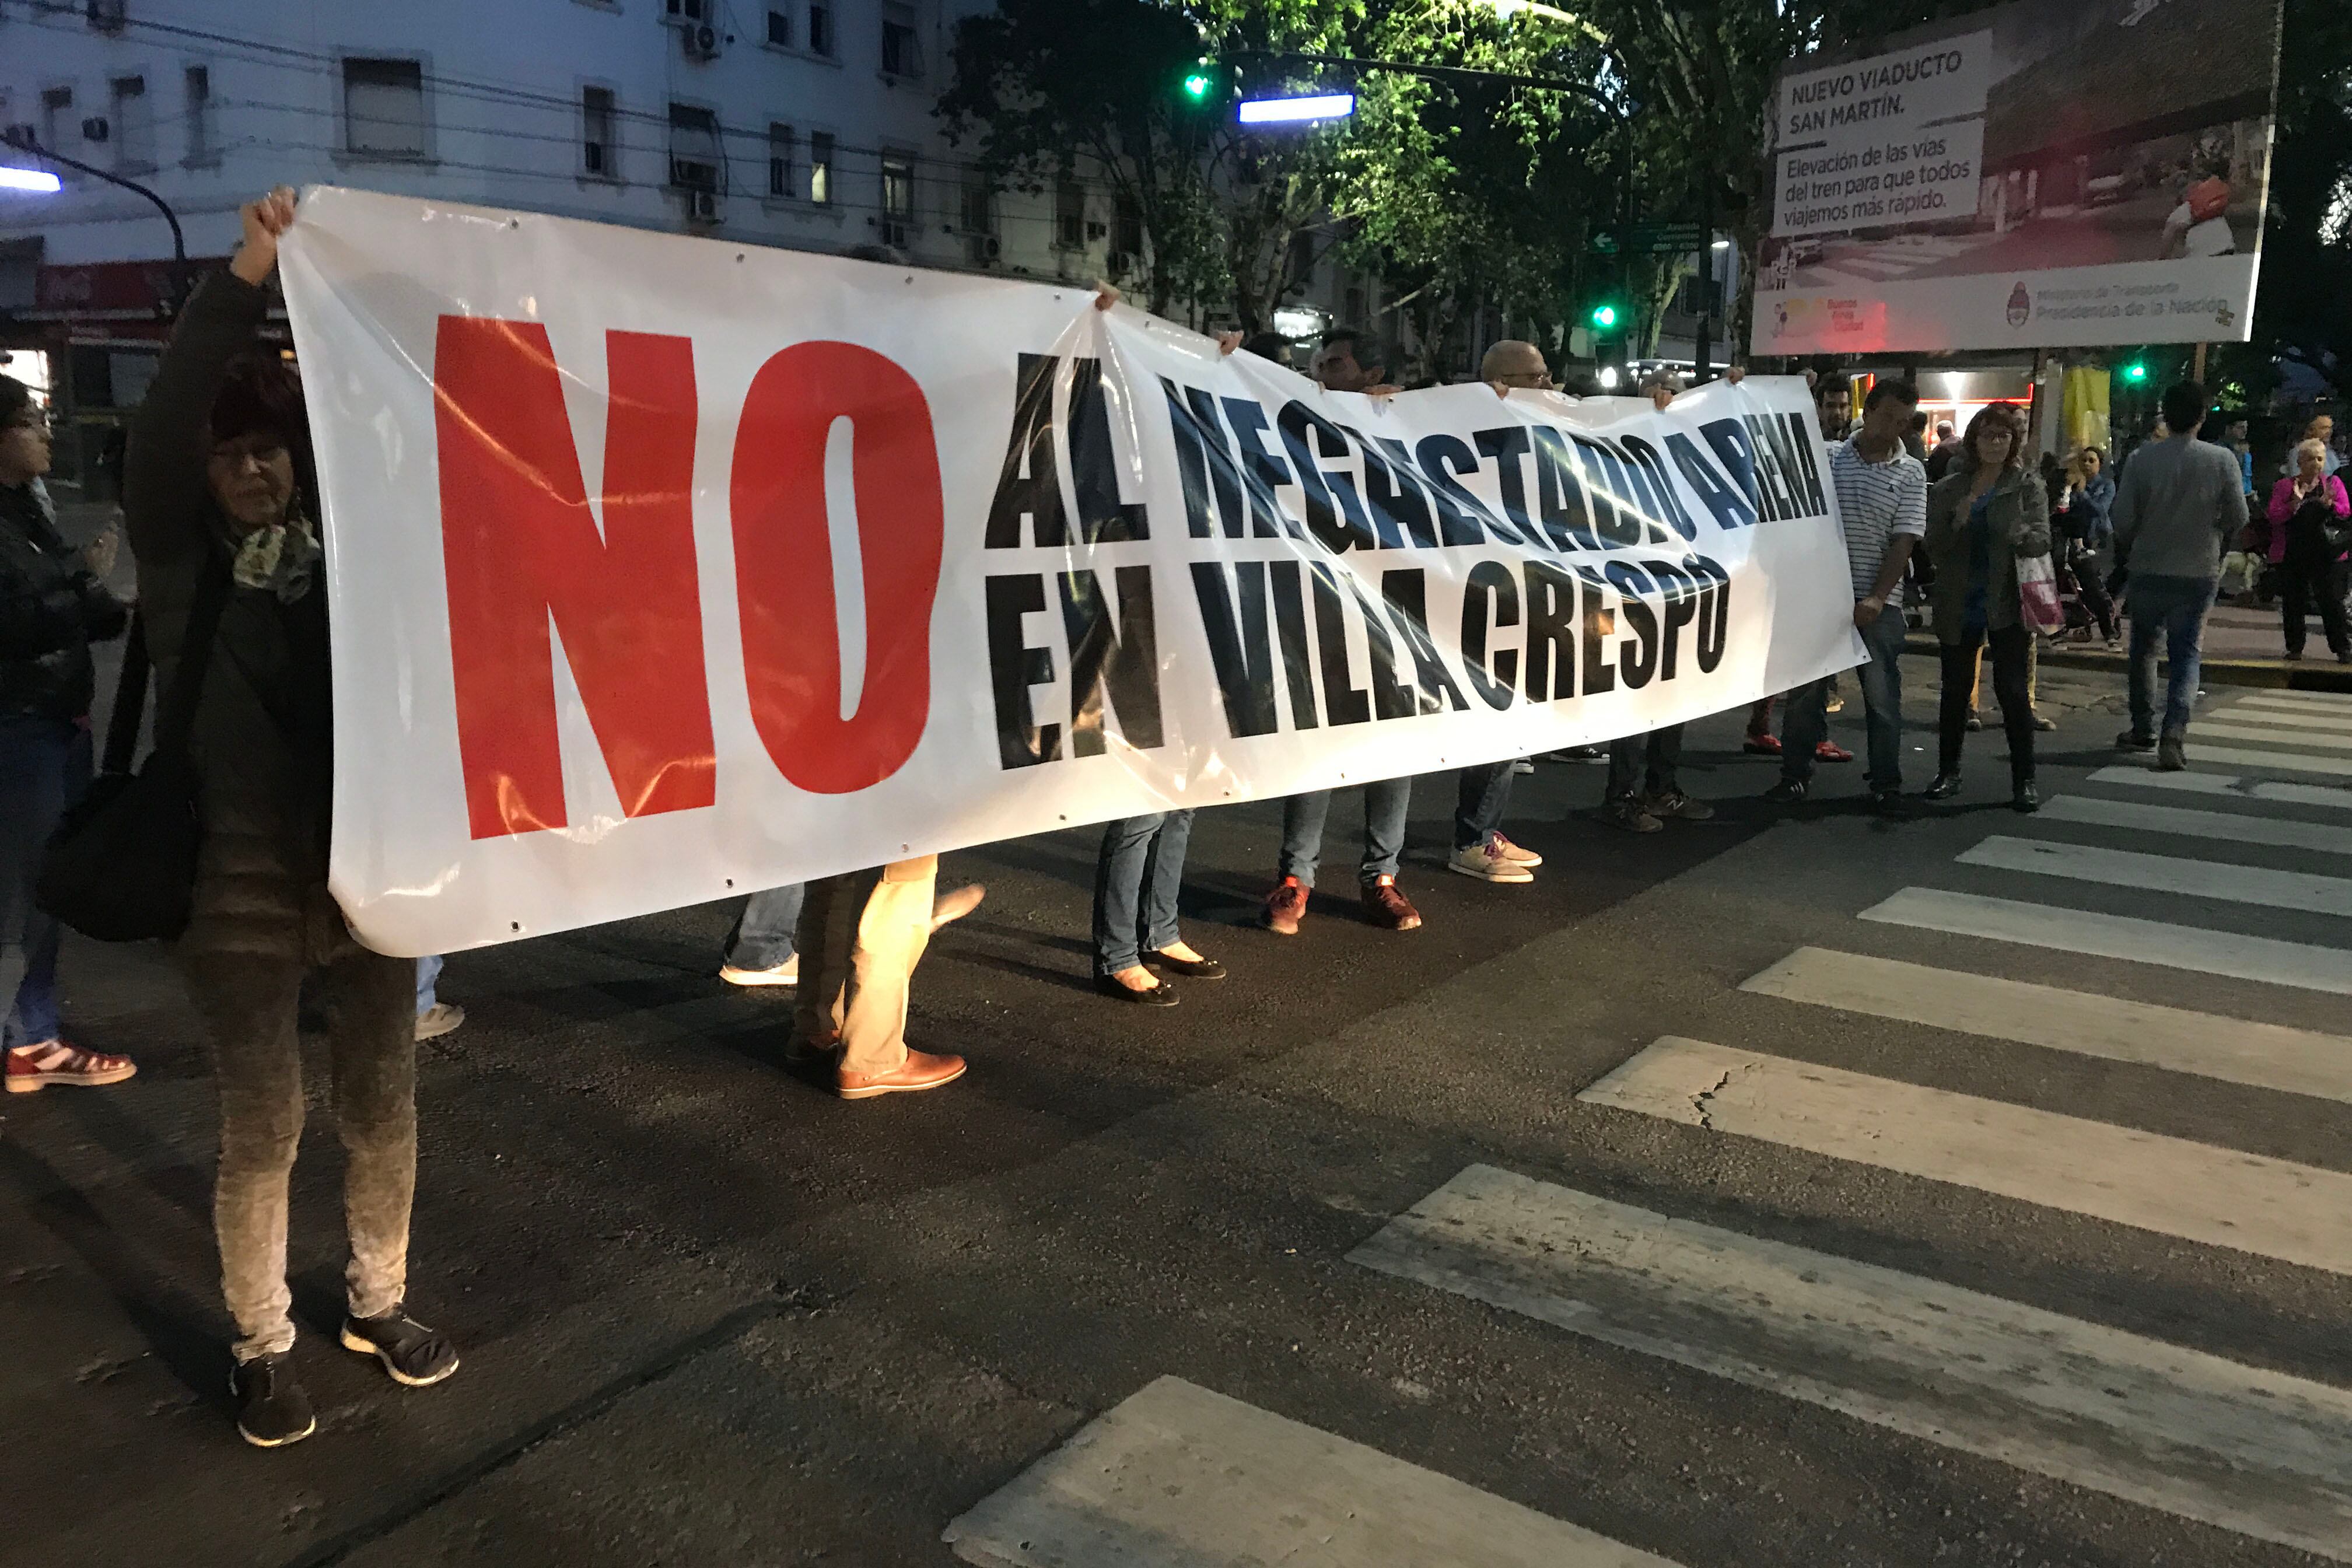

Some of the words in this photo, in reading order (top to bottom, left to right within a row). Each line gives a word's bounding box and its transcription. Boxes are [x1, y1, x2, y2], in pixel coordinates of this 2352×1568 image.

[1791, 75, 1854, 106] NUEVO
[1860, 50, 1962, 92] VIADUCTO
[1790, 109, 1825, 134] SAN
[1831, 91, 1905, 127] MARTÍN.
[1787, 152, 1858, 178] Elevación
[1862, 146, 1882, 166] de
[1885, 143, 1908, 163] las
[1913, 135, 1946, 158] vías
[1786, 181, 1807, 202] del
[1812, 179, 1841, 200] tren
[1846, 174, 1880, 197] para
[1884, 169, 1915, 192] que
[1919, 160, 1971, 184] todos
[1784, 206, 1849, 228] viajemos
[1852, 196, 1884, 219] más
[1889, 189, 1947, 215] rápido.
[2037, 303, 2120, 320] Presidencia
[2125, 301, 2146, 316] de
[2150, 300, 2164, 315] la
[2169, 296, 2228, 314] Nación
[984, 354, 1150, 549] AL
[1662, 412, 1828, 531] ARENA
[433, 314, 944, 840] NO
[988, 565, 1164, 771] EN
[1189, 561, 1471, 739] VILLA
[1461, 554, 1730, 711] CRESPO
